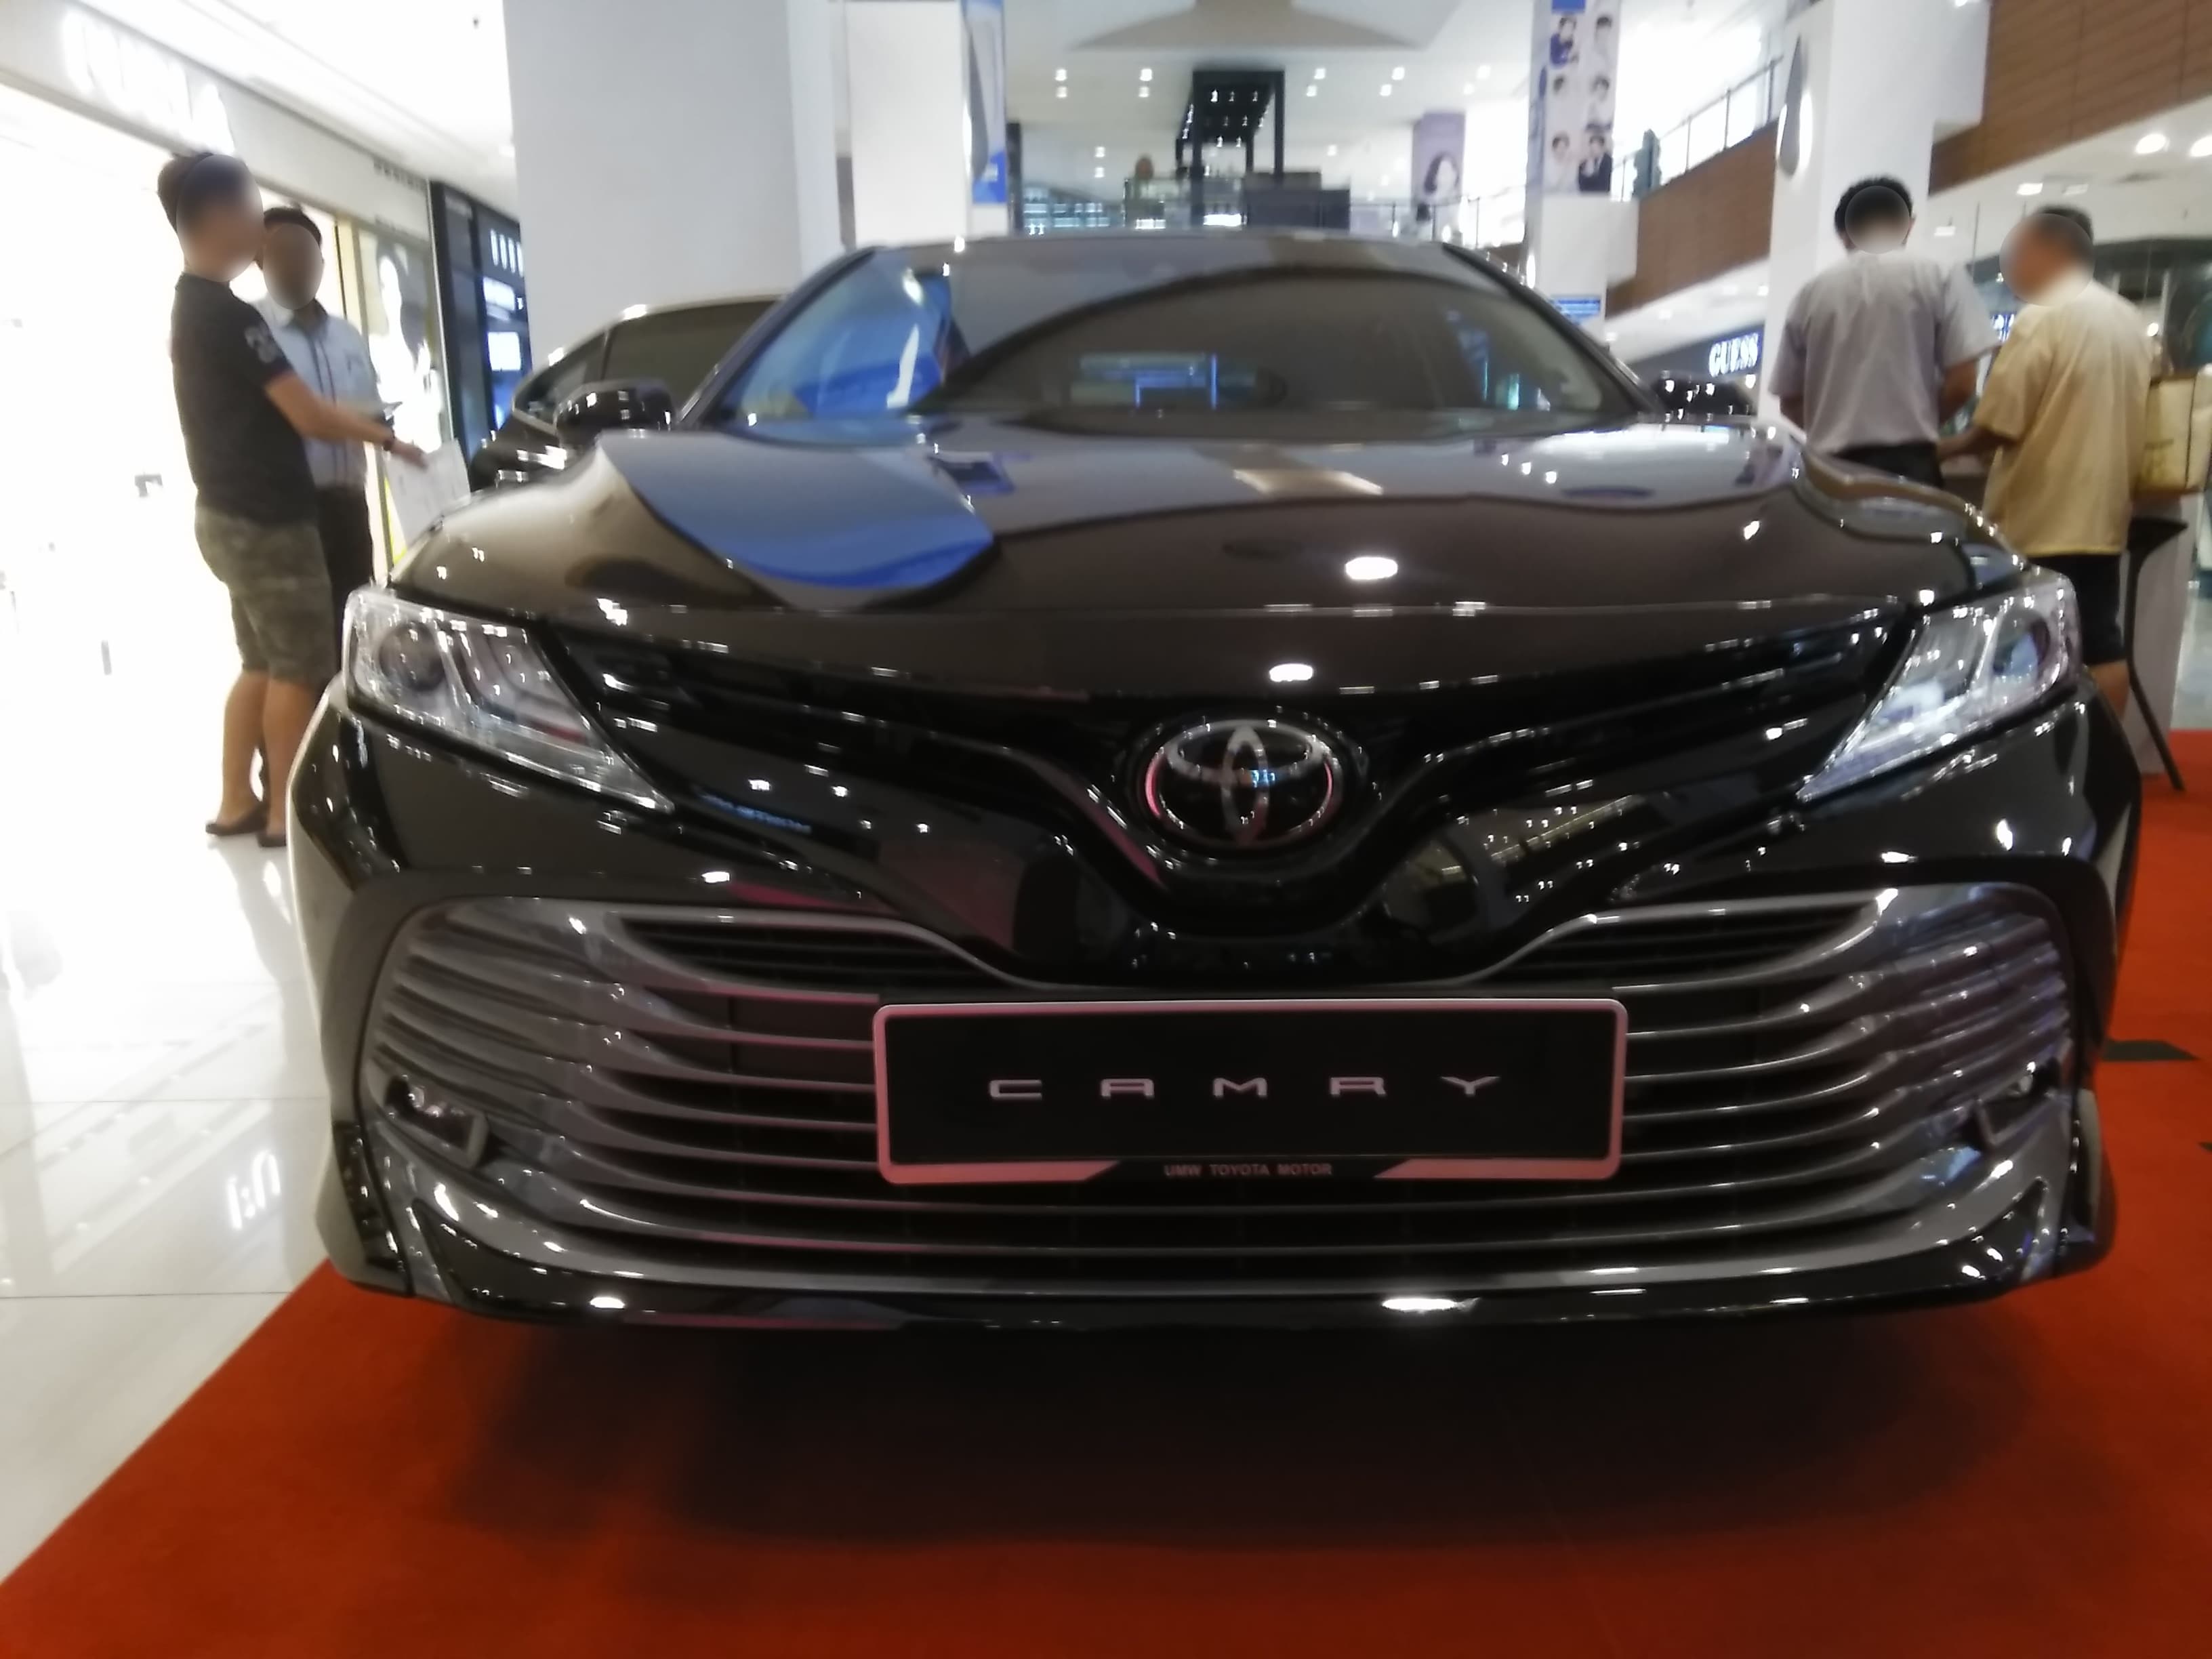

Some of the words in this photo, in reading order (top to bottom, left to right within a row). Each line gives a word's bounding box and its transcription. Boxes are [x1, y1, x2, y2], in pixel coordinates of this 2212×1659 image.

[1708, 333, 1759, 377] GUESS
[988, 1076, 1500, 1099] CAMRY
[1164, 1164, 1202, 1176] UMW
[1209, 1164, 1269, 1176] TOYOTA
[1277, 1163, 1332, 1175] MOTOR
